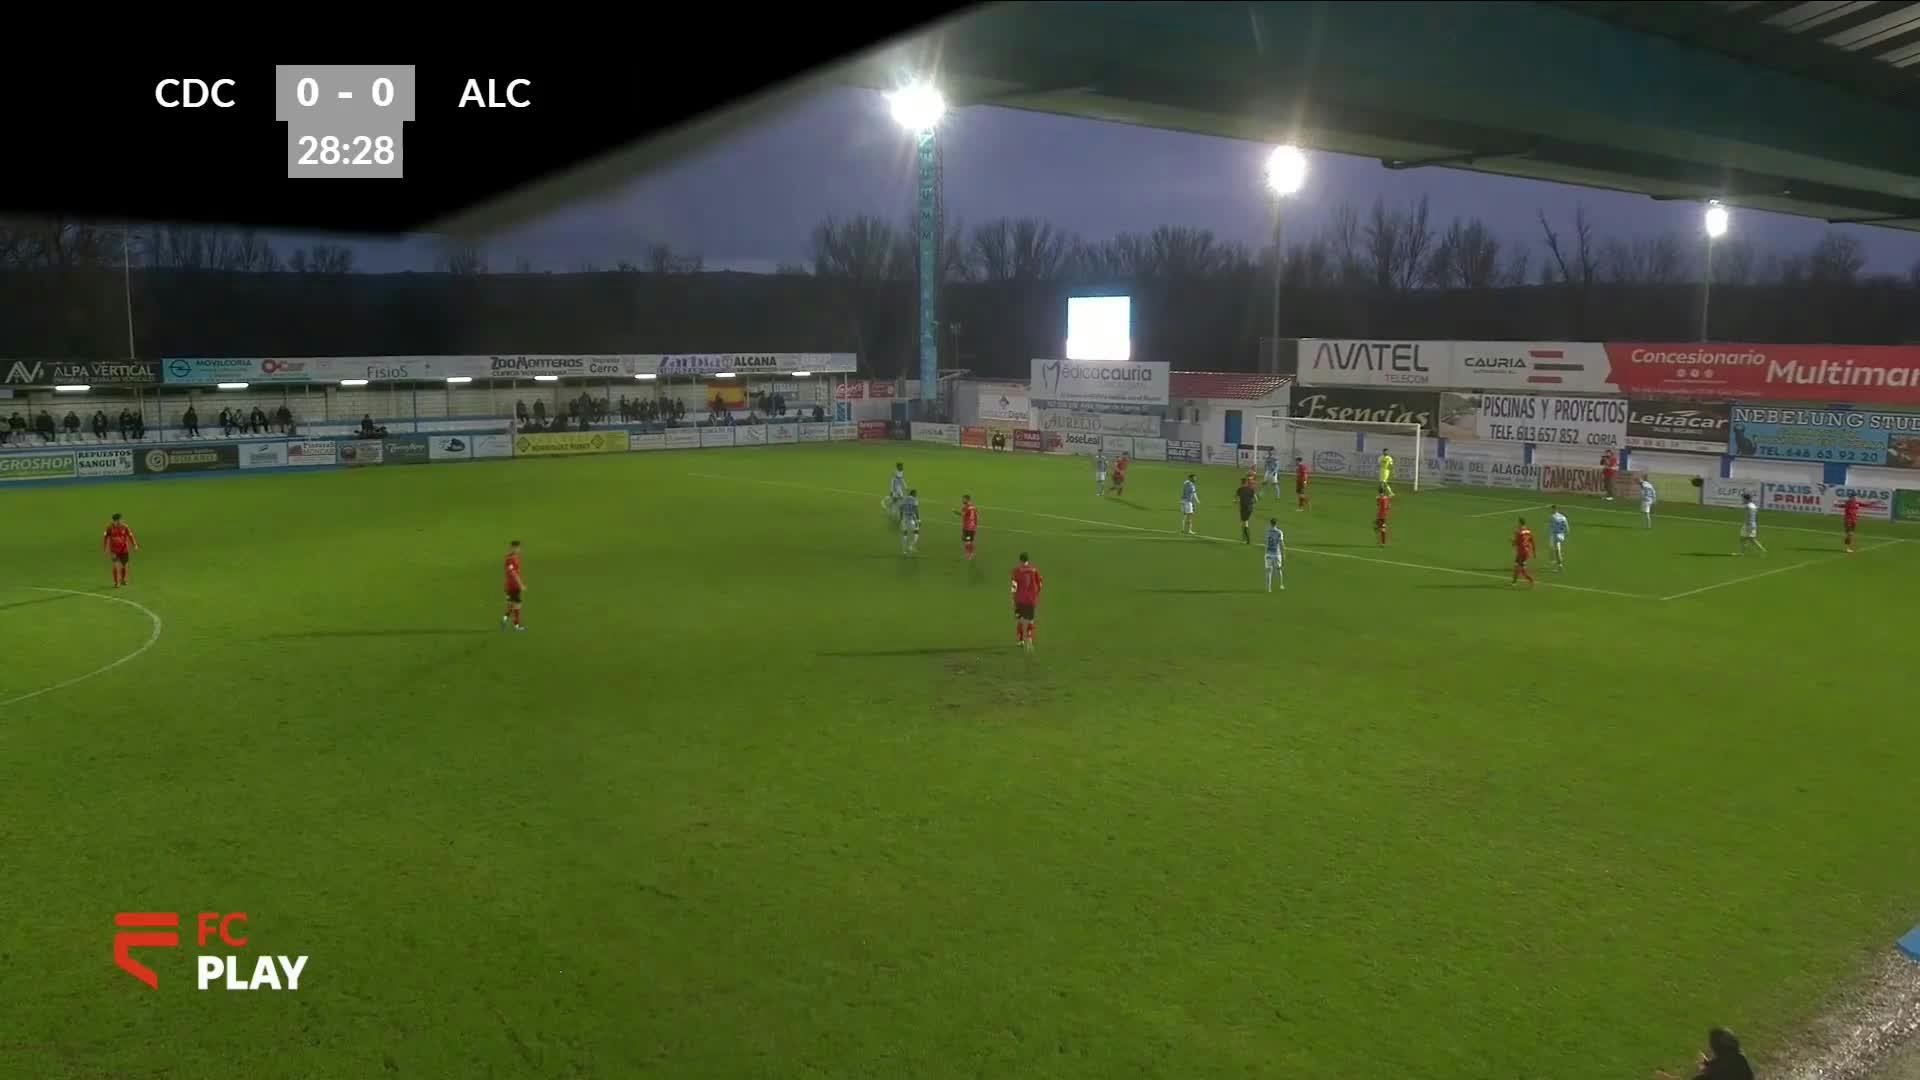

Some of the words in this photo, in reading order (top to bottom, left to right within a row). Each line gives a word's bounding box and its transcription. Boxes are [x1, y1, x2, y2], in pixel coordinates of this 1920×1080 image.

[733, 355, 777, 367] ALCANA
[1312, 342, 1430, 372] AVATEL
[1464, 357, 1527, 369] CAURIA
[1631, 348, 1766, 366] Concesionario
[54, 365, 90, 377] ALPA
[91, 362, 155, 377] VERTICAL
[589, 363, 619, 373] Cerro
[1384, 374, 1429, 384] TELECOM
[1484, 396, 1536, 420] PISCINAS
[1541, 400, 1550, 420] Y
[1554, 399, 1626, 424] PROYECTOS
[1734, 408, 1864, 428] NEBELUNG
[1065, 432, 1101, 445] JoseLeal
[1490, 423, 1514, 441] TELF.
[1517, 425, 1536, 441] 613
[1538, 427, 1557, 443] 657
[1560, 428, 1579, 445] 852
[1586, 432, 1618, 446] CORIA
[79, 449, 132, 459] REPUESTOS
[1816, 449, 1833, 460] 63
[1839, 450, 1856, 461] 92
[1862, 451, 1878, 463] 20
[79, 458, 117, 469] SANGUI
[1469, 461, 1485, 473] DEL
[1491, 463, 1538, 477] ALAGON
[1766, 483, 1812, 495] TAXIS
[1774, 494, 1820, 505] PRIMI
